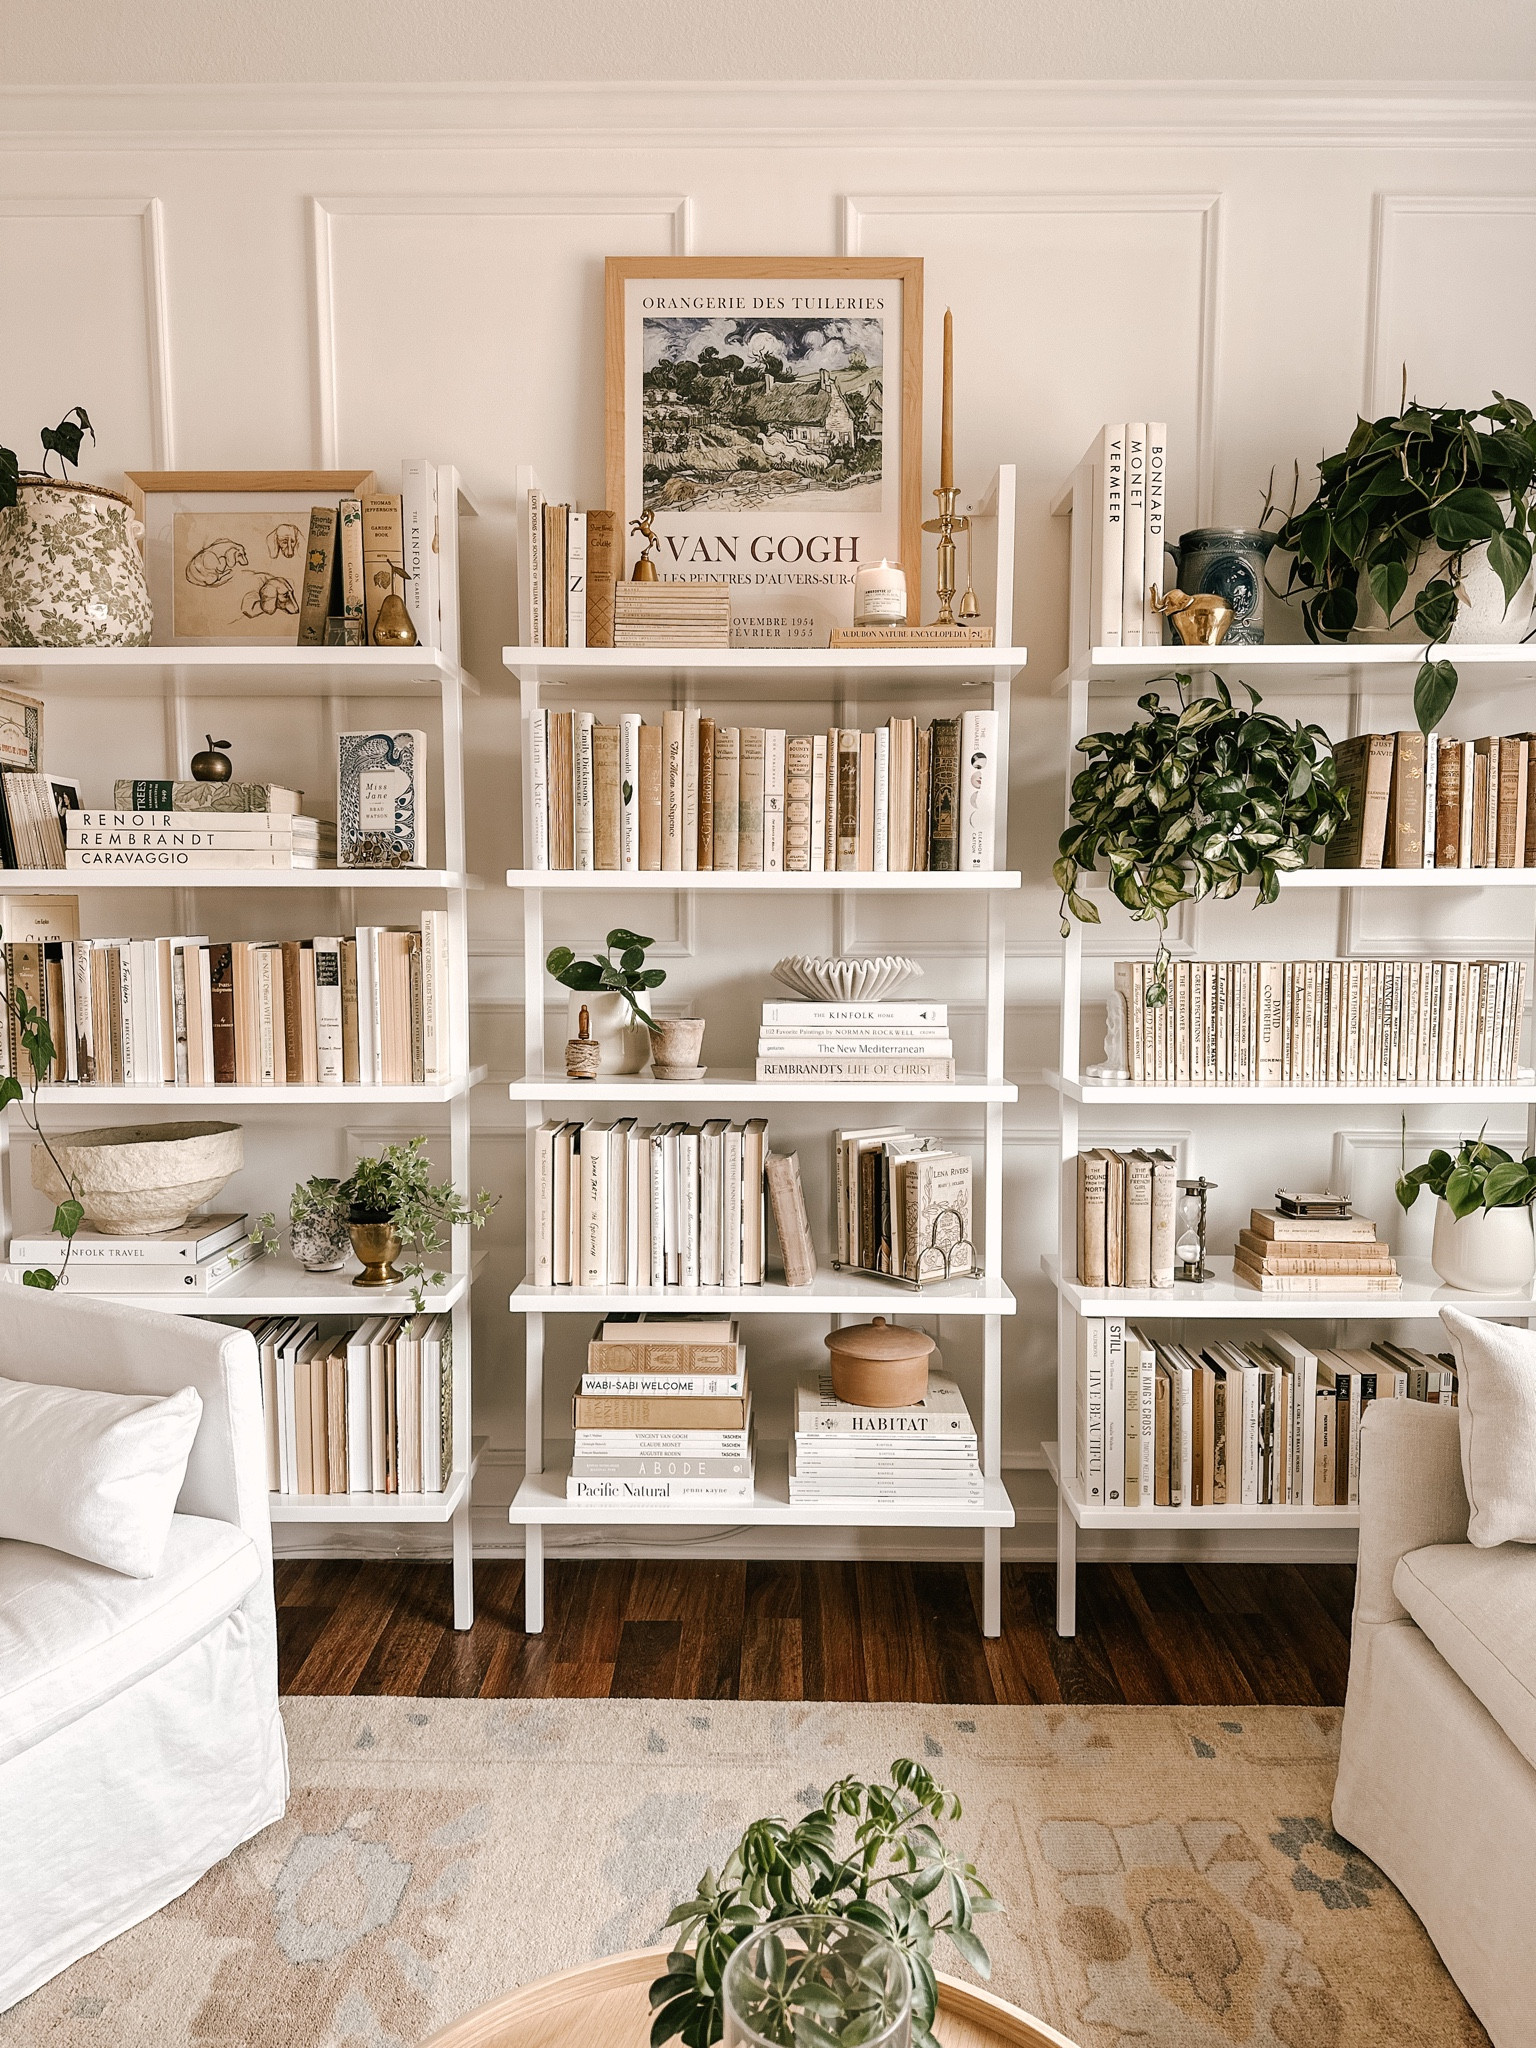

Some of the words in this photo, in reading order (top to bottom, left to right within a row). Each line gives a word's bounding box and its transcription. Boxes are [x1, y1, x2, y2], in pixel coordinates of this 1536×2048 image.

[642, 297, 746, 310] ORANGERIE
[753, 297, 785, 310] DES
[792, 297, 885, 310] TUILERIES
[1108, 440, 1121, 523] VERMEER
[1130, 440, 1143, 508] MONET
[1150, 446, 1163, 535] BONNARD
[590, 537, 612, 548] Colette
[664, 535, 740, 562] VAN
[750, 535, 860, 563] GOGH
[411, 527, 421, 580] KINFOLK
[569, 575, 584, 593] Z
[690, 573, 752, 585] PEINTRES
[755, 573, 856, 585] D'AUVERS-SUR-
[731, 617, 788, 626] OVEMBRE
[791, 617, 815, 626] 1954
[787, 628, 814, 637] 1955
[533, 719, 544, 763] William
[581, 729, 590, 754] Emily
[624, 721, 632, 774] Commonwealth
[669, 741, 679, 761] The
[581, 757, 591, 807] Dickinson's
[669, 761, 679, 788] Moon
[136, 781, 147, 810] TREES
[365, 783, 388, 791] Miss
[365, 792, 388, 800] Jane
[534, 782, 544, 808] Kate
[83, 814, 171, 827] RENOIR
[668, 803, 677, 837] Sixpence
[80, 833, 214, 845] REMBRANDT
[81, 852, 189, 864] CARAVAGGIO
[426, 947, 431, 956] OF
[122, 968, 130, 983] Five
[121, 985, 130, 1004] Years
[1383, 974, 1392, 1028] EVANGELINE
[829, 1011, 875, 1019] KINFOLK
[1263, 984, 1272, 1043] COPPERFIELD
[1272, 1000, 1280, 1029] DAVID
[1350, 991, 1358, 1035] PATHFINDER
[287, 1013, 296, 1058] NANTUCKET
[817, 1044, 835, 1053] The
[836, 1044, 857, 1053] New
[859, 1044, 925, 1054] Mediterranean
[763, 1064, 843, 1075] REMBRANDT'S
[847, 1064, 870, 1075] LIFE
[873, 1064, 890, 1075] OF
[893, 1064, 932, 1075] CHRIST
[590, 1156, 599, 1177] DONNA
[933, 1170, 949, 1179] LENA
[950, 1167, 969, 1176] RIVERS
[589, 1222, 600, 1256] GOLDFINCH
[60, 1249, 105, 1257] KINFOLK
[109, 1249, 145, 1257] TRAVEL
[1110, 1325, 1121, 1354] STILL
[585, 1381, 639, 1390] WABI-SABI
[641, 1381, 694, 1391] WELCOME
[1089, 1370, 1101, 1398] LIVE
[1142, 1376, 1151, 1405] KING'S
[1181, 1388, 1189, 1406] Think
[852, 1417, 929, 1431] HABITAT
[1142, 1408, 1151, 1436] CROSS
[1089, 1403, 1101, 1476] BEAUTIFUL
[638, 1462, 706, 1475] ABODE
[577, 1482, 619, 1497] Pacific
[622, 1482, 670, 1497] Natural
